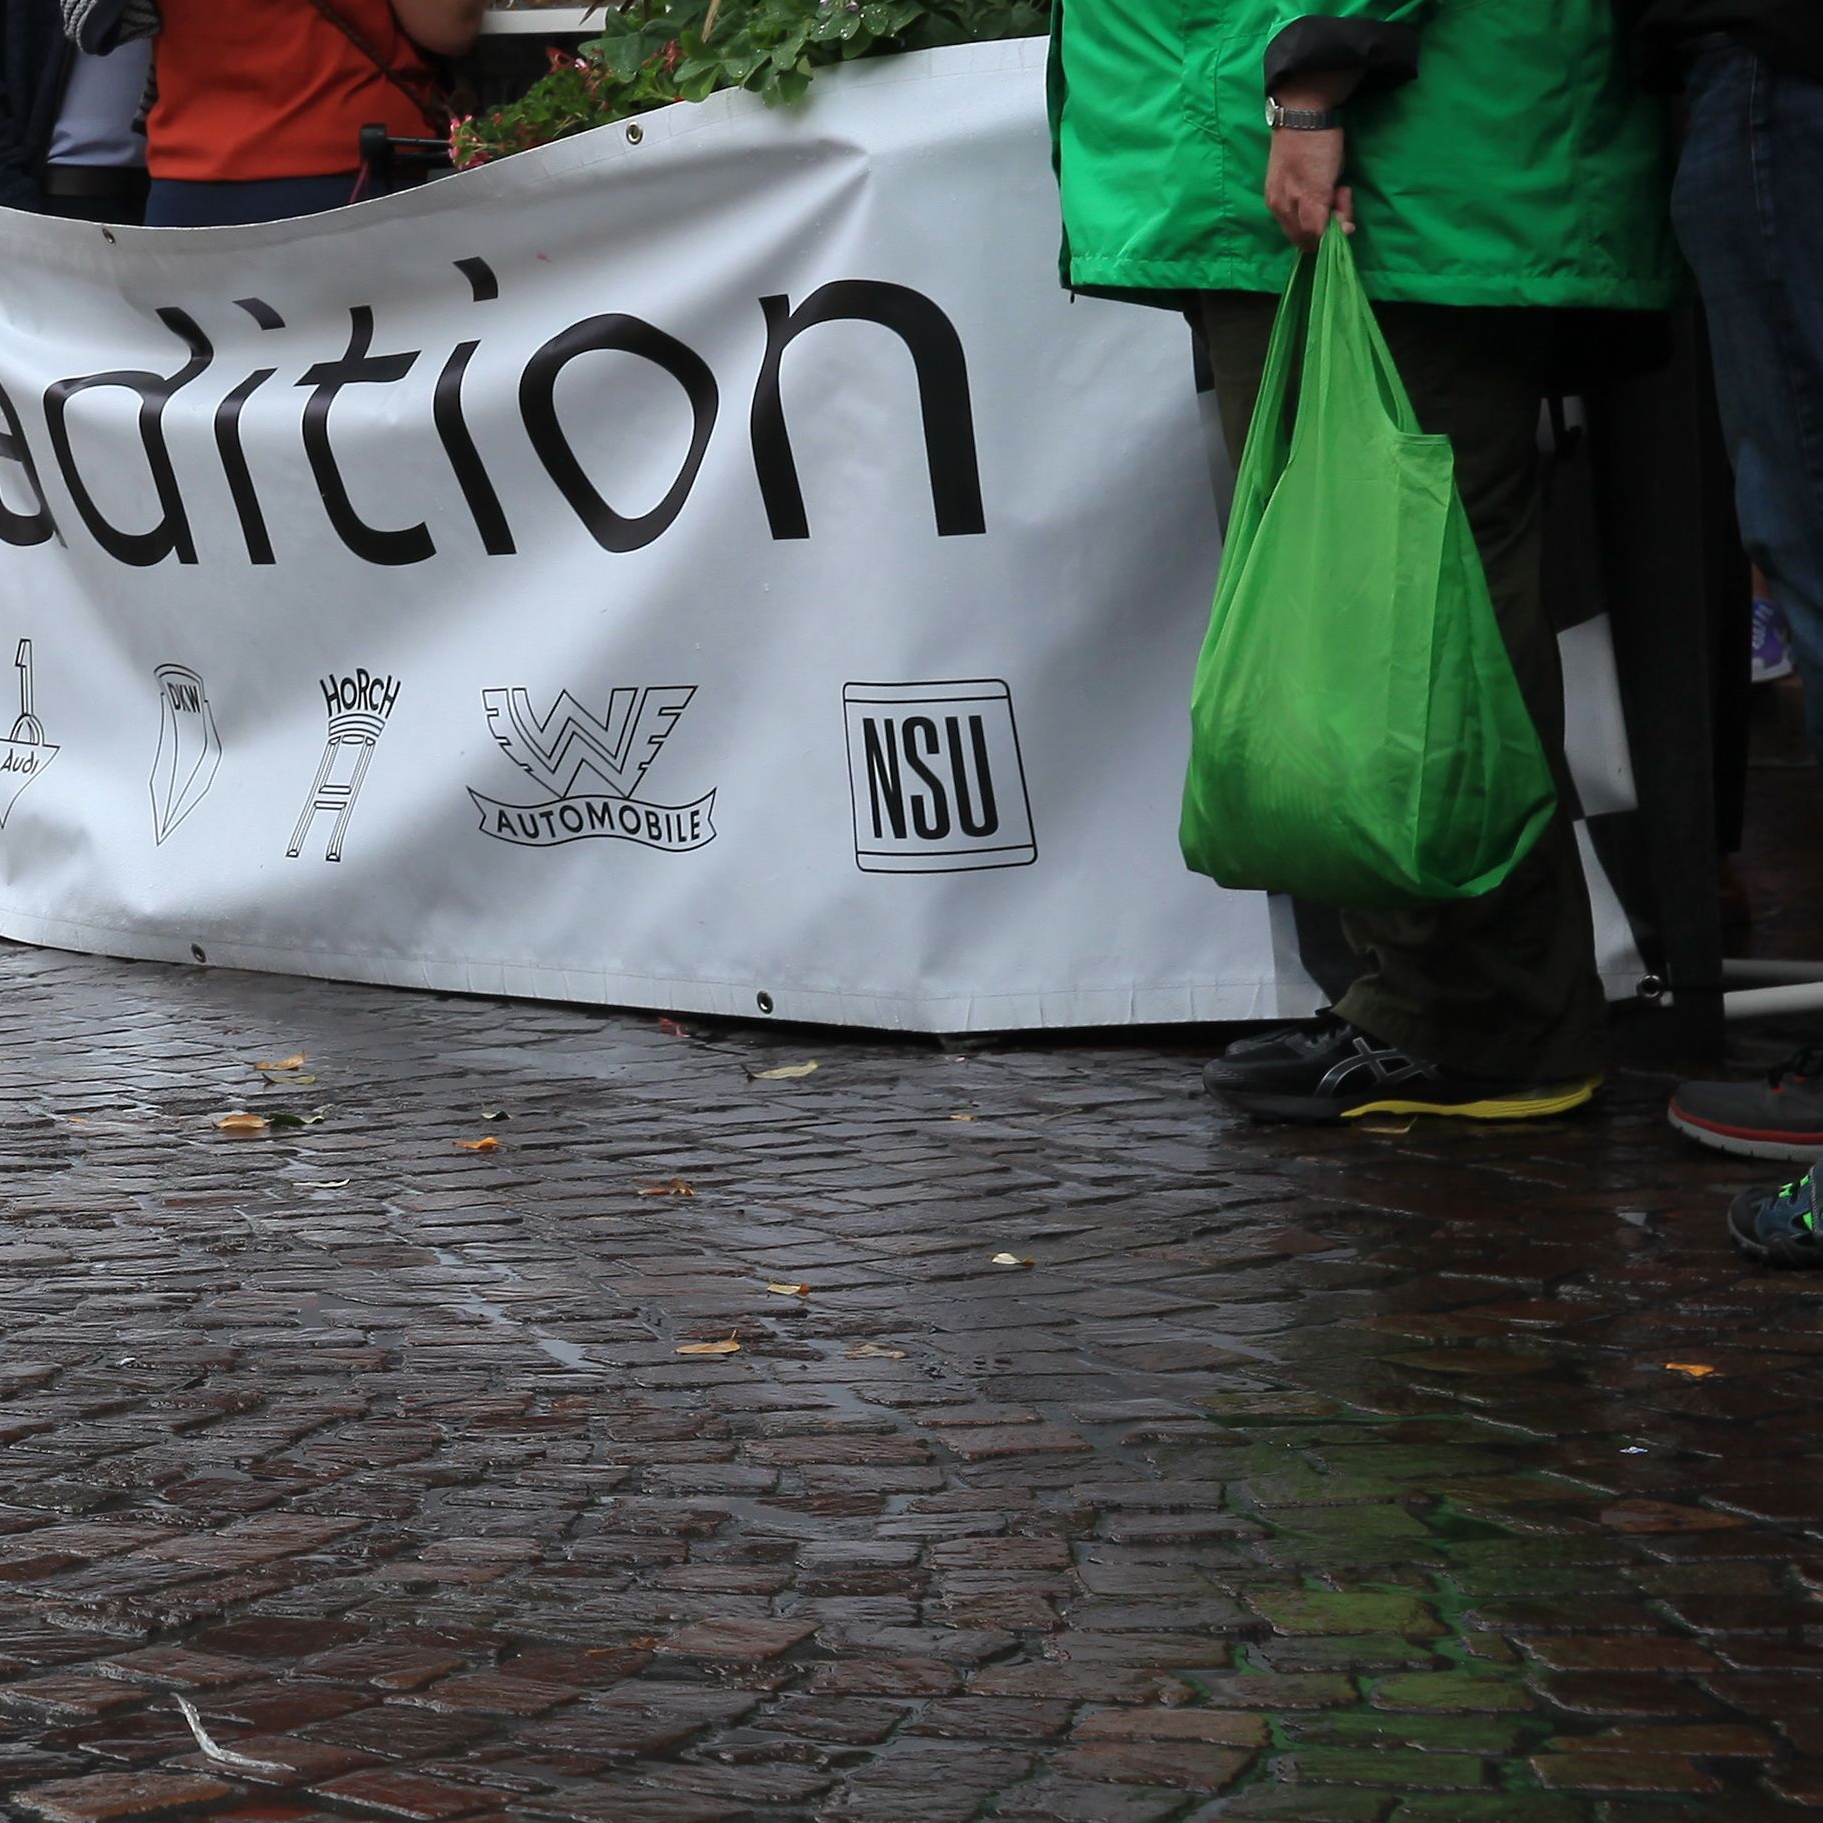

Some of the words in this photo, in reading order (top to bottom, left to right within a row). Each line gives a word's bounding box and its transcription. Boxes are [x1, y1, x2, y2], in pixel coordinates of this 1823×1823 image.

[167, 682, 202, 715] DKW
[319, 667, 401, 720] HORCH
[0, 748, 40, 777] Audi
[862, 714, 999, 841] NSU
[495, 801, 703, 846] AUTOMOBILE
